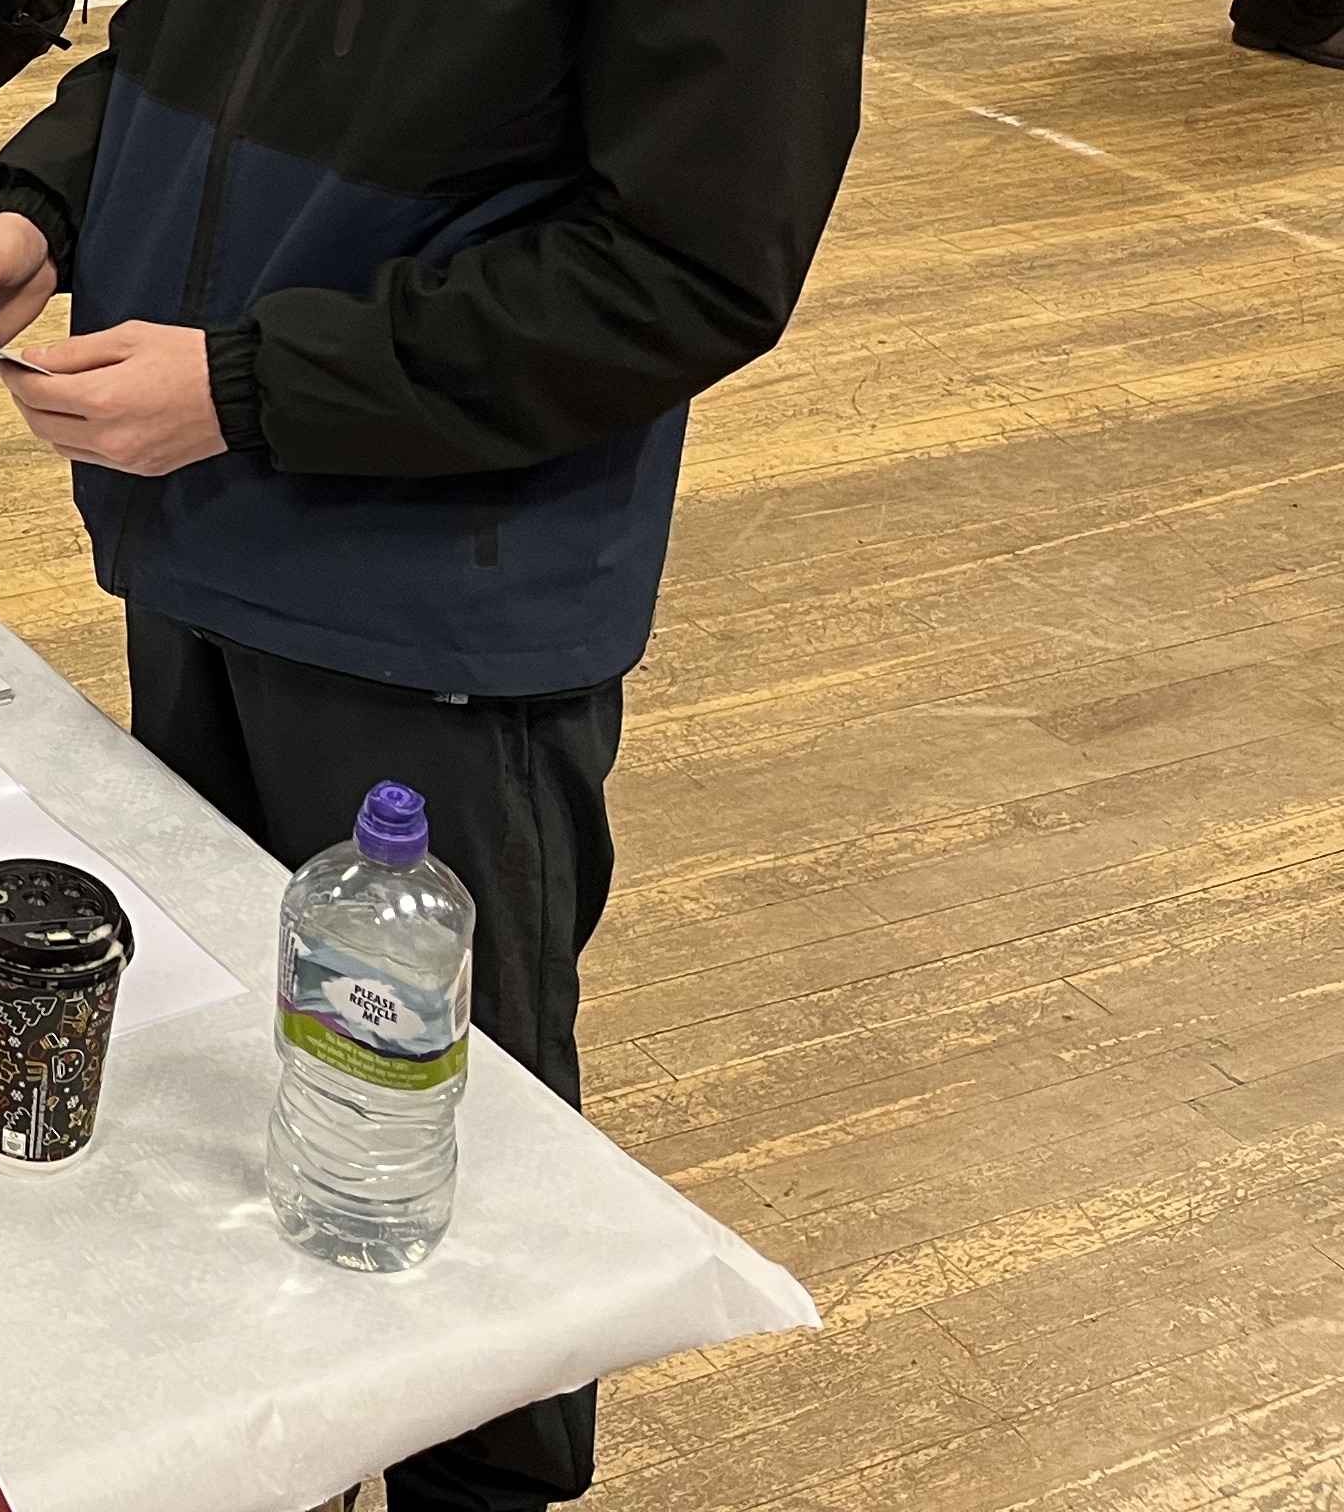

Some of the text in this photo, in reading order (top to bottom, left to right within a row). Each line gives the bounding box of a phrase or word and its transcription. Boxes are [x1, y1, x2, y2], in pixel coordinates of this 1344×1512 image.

[349, 993, 398, 1024] RECYCLE
[354, 983, 396, 1012] PLEASE
[362, 1012, 380, 1027] ME
